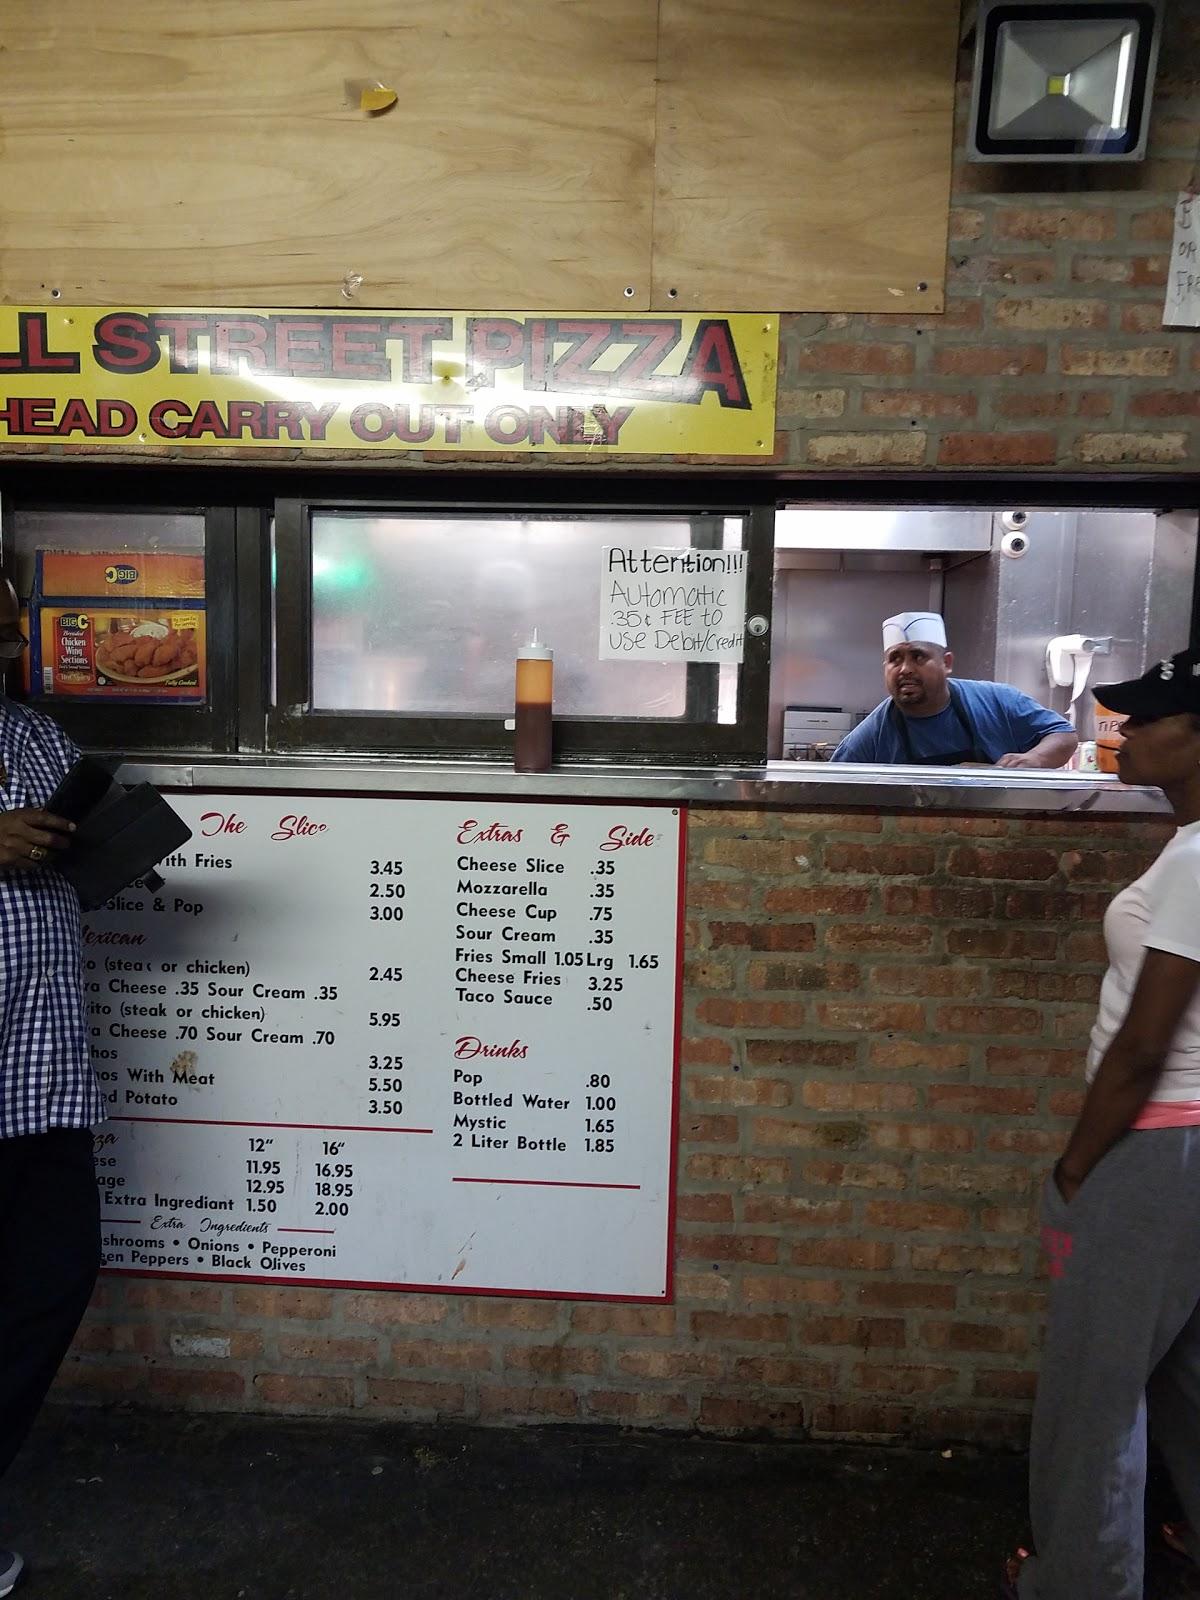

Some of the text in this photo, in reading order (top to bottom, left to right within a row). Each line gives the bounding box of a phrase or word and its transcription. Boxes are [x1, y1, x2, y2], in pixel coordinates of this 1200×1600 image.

[91, 312, 455, 384] STREET
[466, 318, 754, 410] PIZZA
[147, 398, 341, 440] CARRY
[347, 401, 479, 444] OUT
[482, 403, 637, 448] ONLY
[608, 547, 744, 575] Attention!!!
[661, 608, 695, 627] FEE
[61, 637, 86, 646] Chicken
[65, 646, 83, 656] Wing
[654, 629, 745, 653] Debit/Credit
[60, 655, 89, 664] Sections
[200, 811, 248, 837] The
[456, 819, 664, 852] Extras & Side
[156, 853, 404, 876] ith Fries 3.45
[456, 856, 616, 876] Cheese Slice .35
[369, 884, 406, 899] 2.50
[456, 880, 615, 898] Mozzarella .35
[153, 899, 165, 913] &
[174, 900, 204, 917] Pop
[369, 906, 404, 922] 3.00
[456, 902, 613, 922] Cheese Cup .75
[82, 925, 147, 947] exican
[455, 925, 614, 945] Sour Cream .35
[160, 961, 177, 974] or
[185, 958, 251, 977] chicken)
[368, 967, 403, 982] 2.45
[455, 948, 659, 971] Fries Small 1.05 Lrg 1.65
[108, 979, 167, 995] Cheese
[175, 981, 200, 996] .35
[207, 982, 245, 998] Sour
[252, 984, 306, 1000] Cream
[313, 986, 339, 1001] .35
[455, 968, 624, 992] Cheese Fries 3.25
[455, 987, 613, 1012] Taco Sauce .50
[119, 1002, 168, 1019] (steak
[175, 1008, 193, 1019] or
[201, 1005, 266, 1022] chicken)
[368, 1012, 401, 1028] 5.95
[109, 1024, 167, 1040] Cheese
[175, 1026, 199, 1042] .70
[206, 1026, 245, 1043] Sour
[251, 1028, 304, 1045] Cream
[311, 1031, 335, 1046] .70
[453, 1036, 528, 1060] Drinks
[368, 1055, 404, 1071] 3.25
[126, 1068, 165, 1085] With
[171, 1072, 215, 1087] Meat
[368, 1078, 403, 1093] 5.50
[453, 1069, 611, 1089] Pop .80
[125, 1090, 179, 1107] Potato
[368, 1100, 404, 1115] 3.50
[452, 1092, 616, 1111] Bottled Water 1.00
[453, 1114, 615, 1134] Mystic 1.65
[452, 1133, 615, 1153] 2 Liter Bottle 1.85
[246, 1160, 281, 1175] 11.95
[315, 1163, 354, 1178] 16.95
[246, 1179, 285, 1194] 12.95
[315, 1183, 354, 1198] 18.95
[104, 1192, 349, 1217] Extra Ingrediant 1.50 2.00
[150, 1216, 272, 1237] Extra Ingredients
[101, 1234, 337, 1259] shrooms Onions Pepperoni
[131, 1251, 190, 1269] Peppers
[211, 1254, 252, 1270] Black
[260, 1257, 307, 1272] Olives
